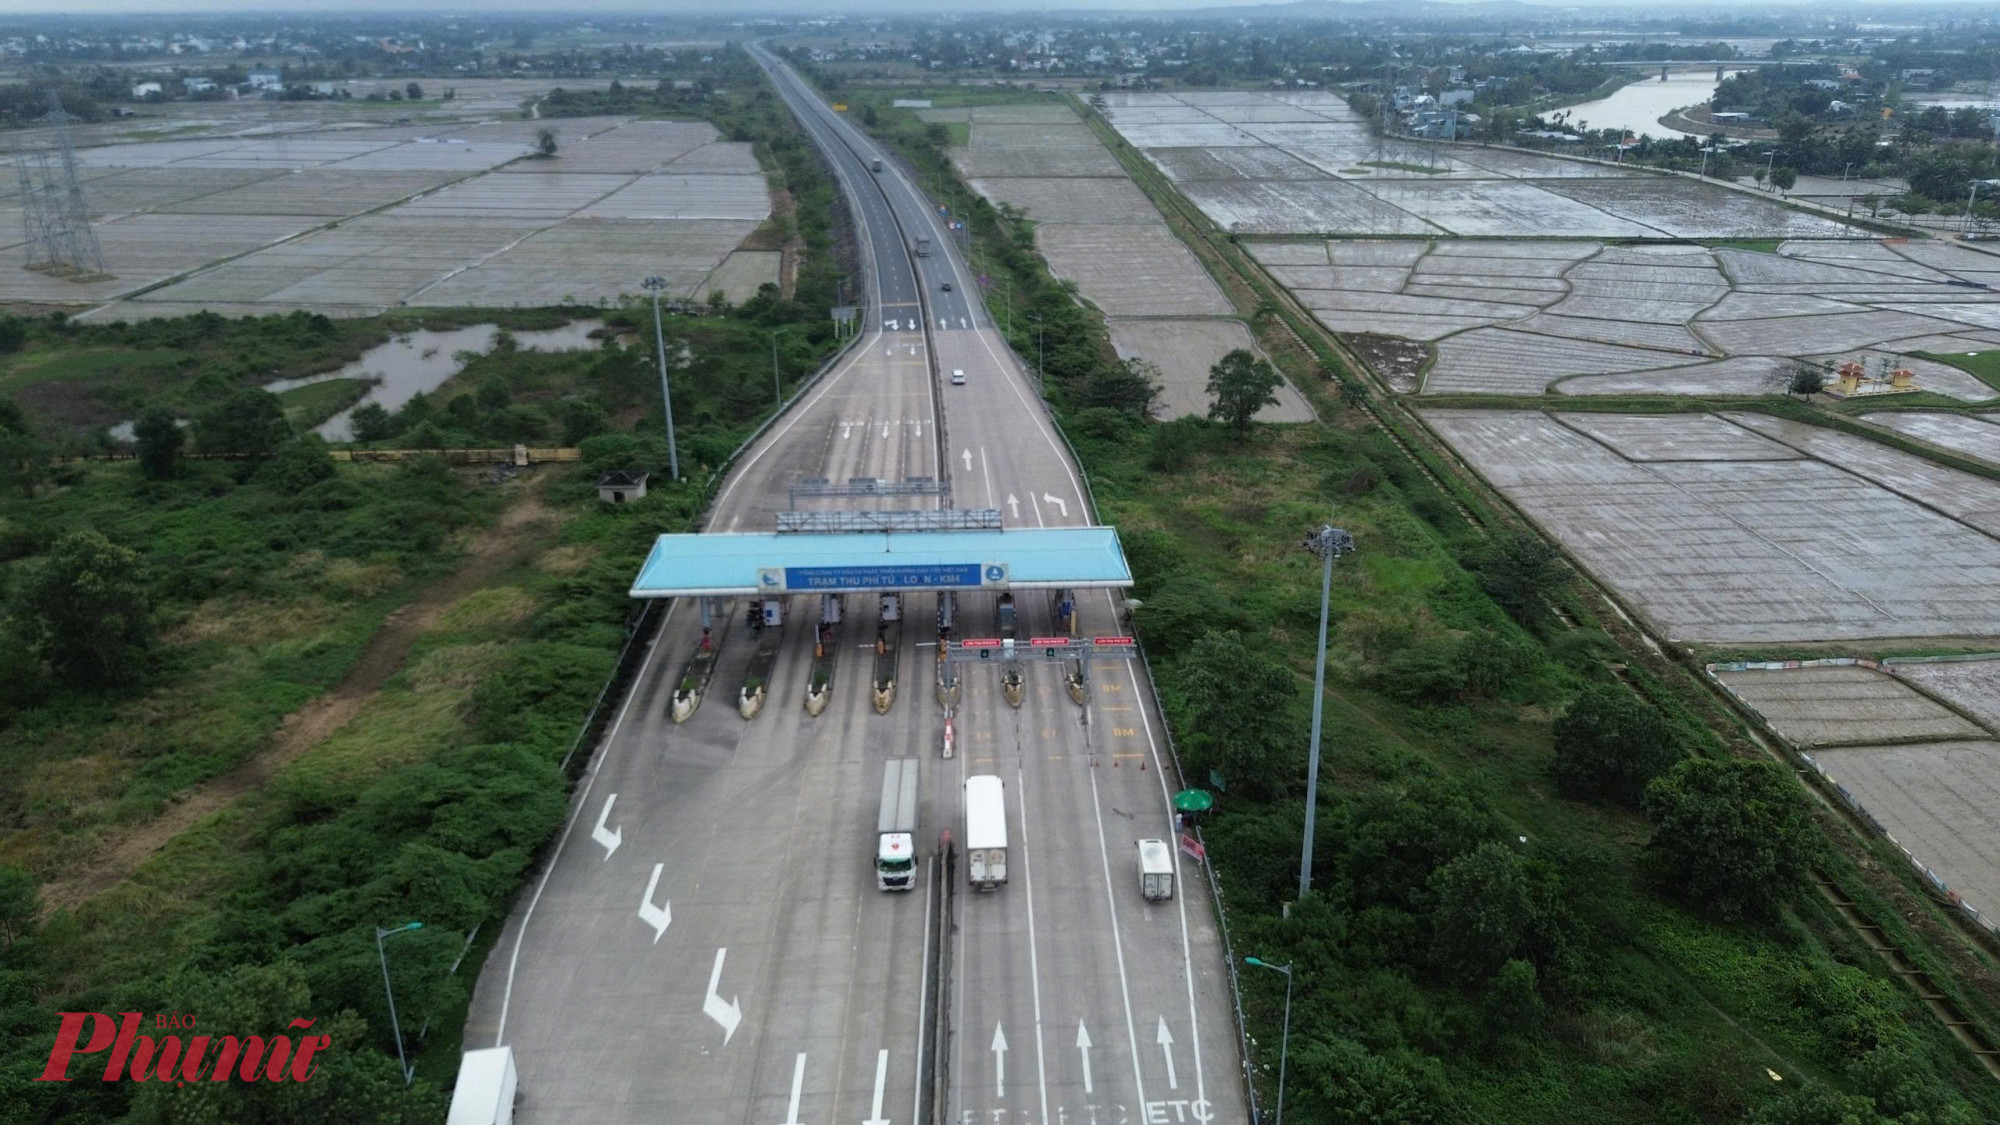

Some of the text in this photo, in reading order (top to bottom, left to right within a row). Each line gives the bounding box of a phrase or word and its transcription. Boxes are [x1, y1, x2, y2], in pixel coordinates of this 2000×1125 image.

[840, 577, 860, 585] THU
[904, 575, 932, 584] LON
[1146, 1099, 1215, 1124] ETC
